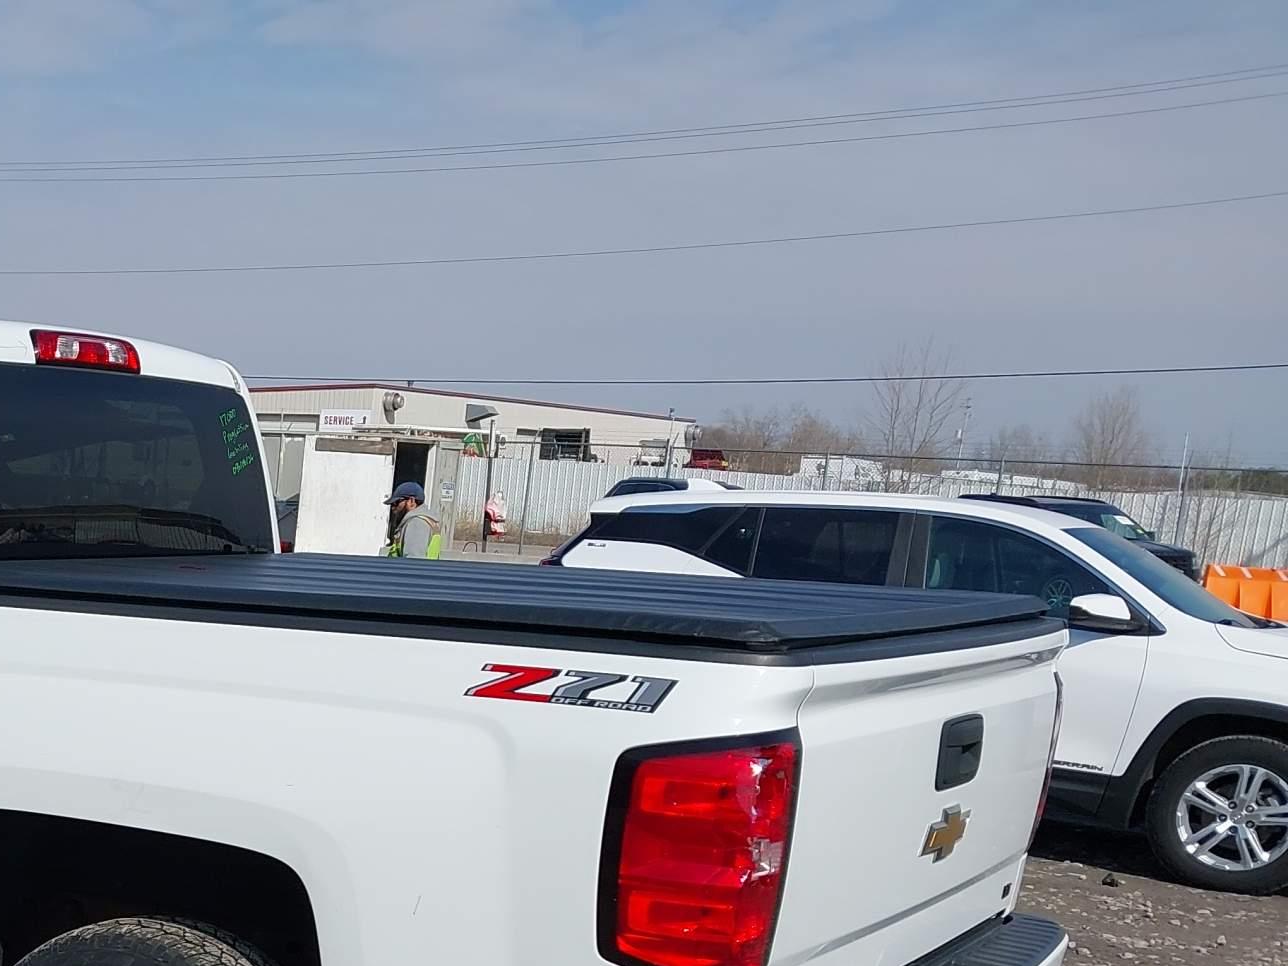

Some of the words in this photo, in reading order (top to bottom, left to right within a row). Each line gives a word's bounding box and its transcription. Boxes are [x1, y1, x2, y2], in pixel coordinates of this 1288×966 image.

[324, 415, 354, 426] SERVICE
[463, 663, 680, 713] Z71
[551, 696, 590, 707] OFF
[593, 701, 652, 713] ROAD
